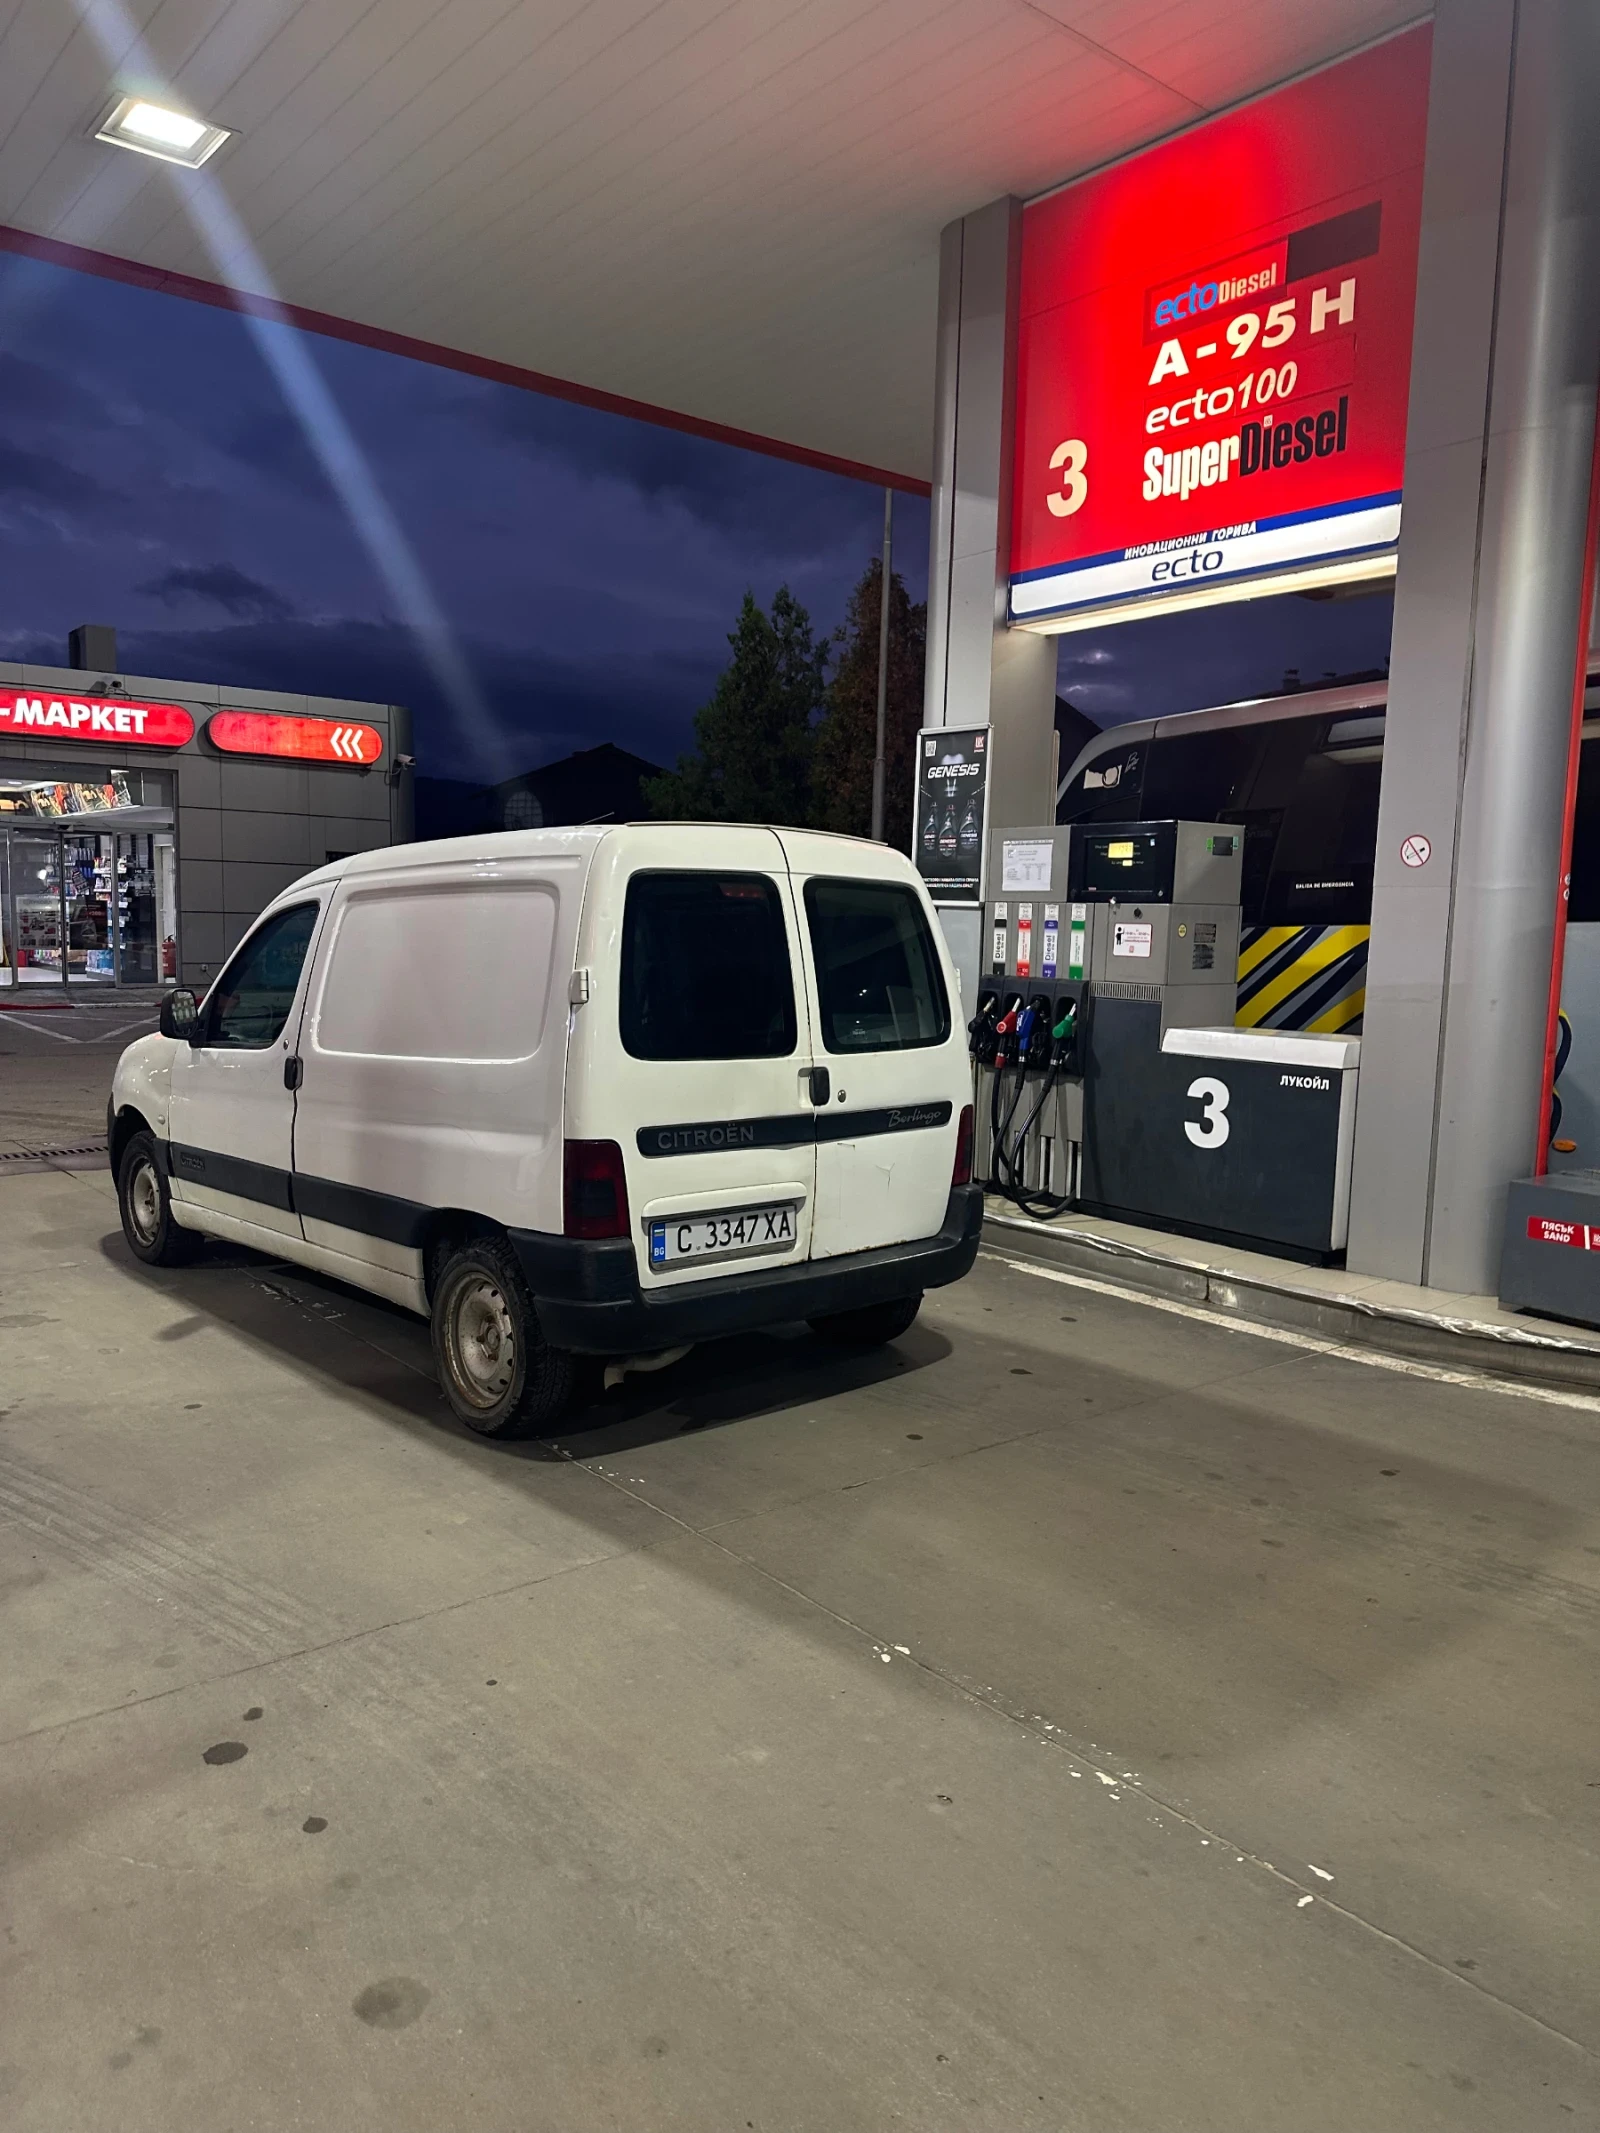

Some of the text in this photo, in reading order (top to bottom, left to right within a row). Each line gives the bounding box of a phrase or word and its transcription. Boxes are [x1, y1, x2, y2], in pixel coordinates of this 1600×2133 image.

[1046, 439, 1088, 518] 3
[1124, 520, 1257, 560] ИНОВАЦИОННИ ГОРИВА
[1151, 549, 1224, 582] ecto
[927, 763, 980, 779] GENESIS
[1279, 1074, 1330, 1091] ЛУКОЙЛ
[887, 1109, 942, 1128] Berlingo
[1184, 1076, 1230, 1149] 3
[657, 1123, 754, 1149] CITROËN
[705, 1214, 760, 1249] 3347
[764, 1211, 792, 1241] XA
[1541, 1221, 1575, 1234] ПЯСЪК
[1543, 1230, 1571, 1243] SAND
[653, 1246, 665, 1257] BG
